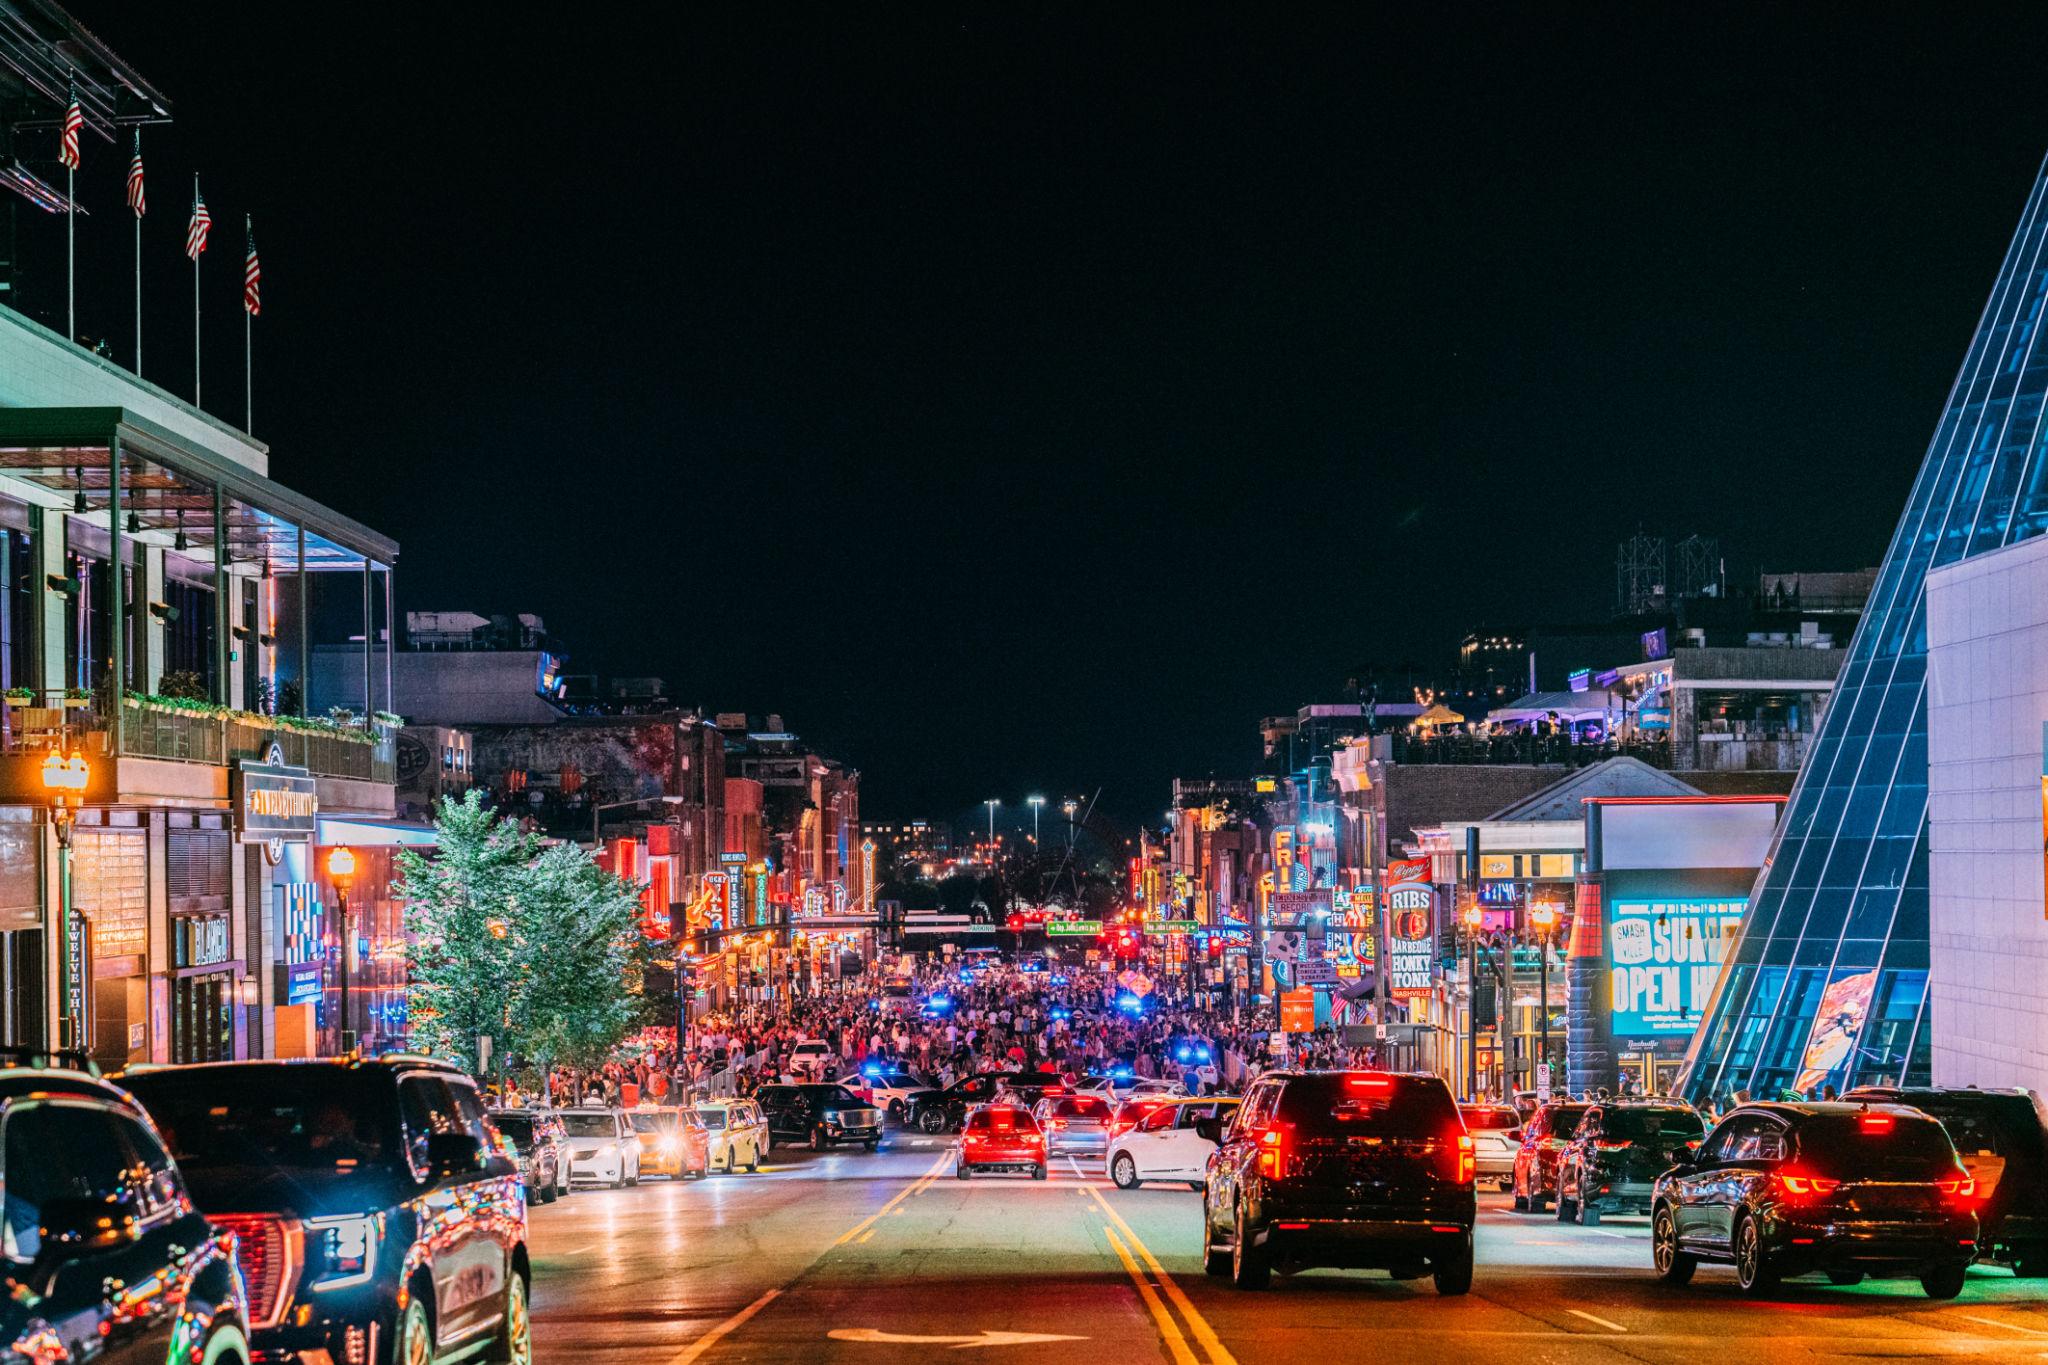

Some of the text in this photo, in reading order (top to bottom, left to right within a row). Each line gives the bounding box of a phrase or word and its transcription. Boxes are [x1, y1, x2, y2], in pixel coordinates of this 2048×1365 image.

[728, 866, 739, 928] WHISKEY
[1392, 890, 1430, 909] RIBS
[1616, 923, 1645, 940] SMASH
[195, 918, 227, 966] BLANCO
[1392, 937, 1432, 954] BARBEQUE
[69, 921, 80, 983] TWELVE
[1392, 955, 1432, 972] HONKY
[1393, 972, 1432, 988] TONK
[1393, 989, 1431, 997] NASHVILLE
[1613, 966, 1680, 1013] OPEN
